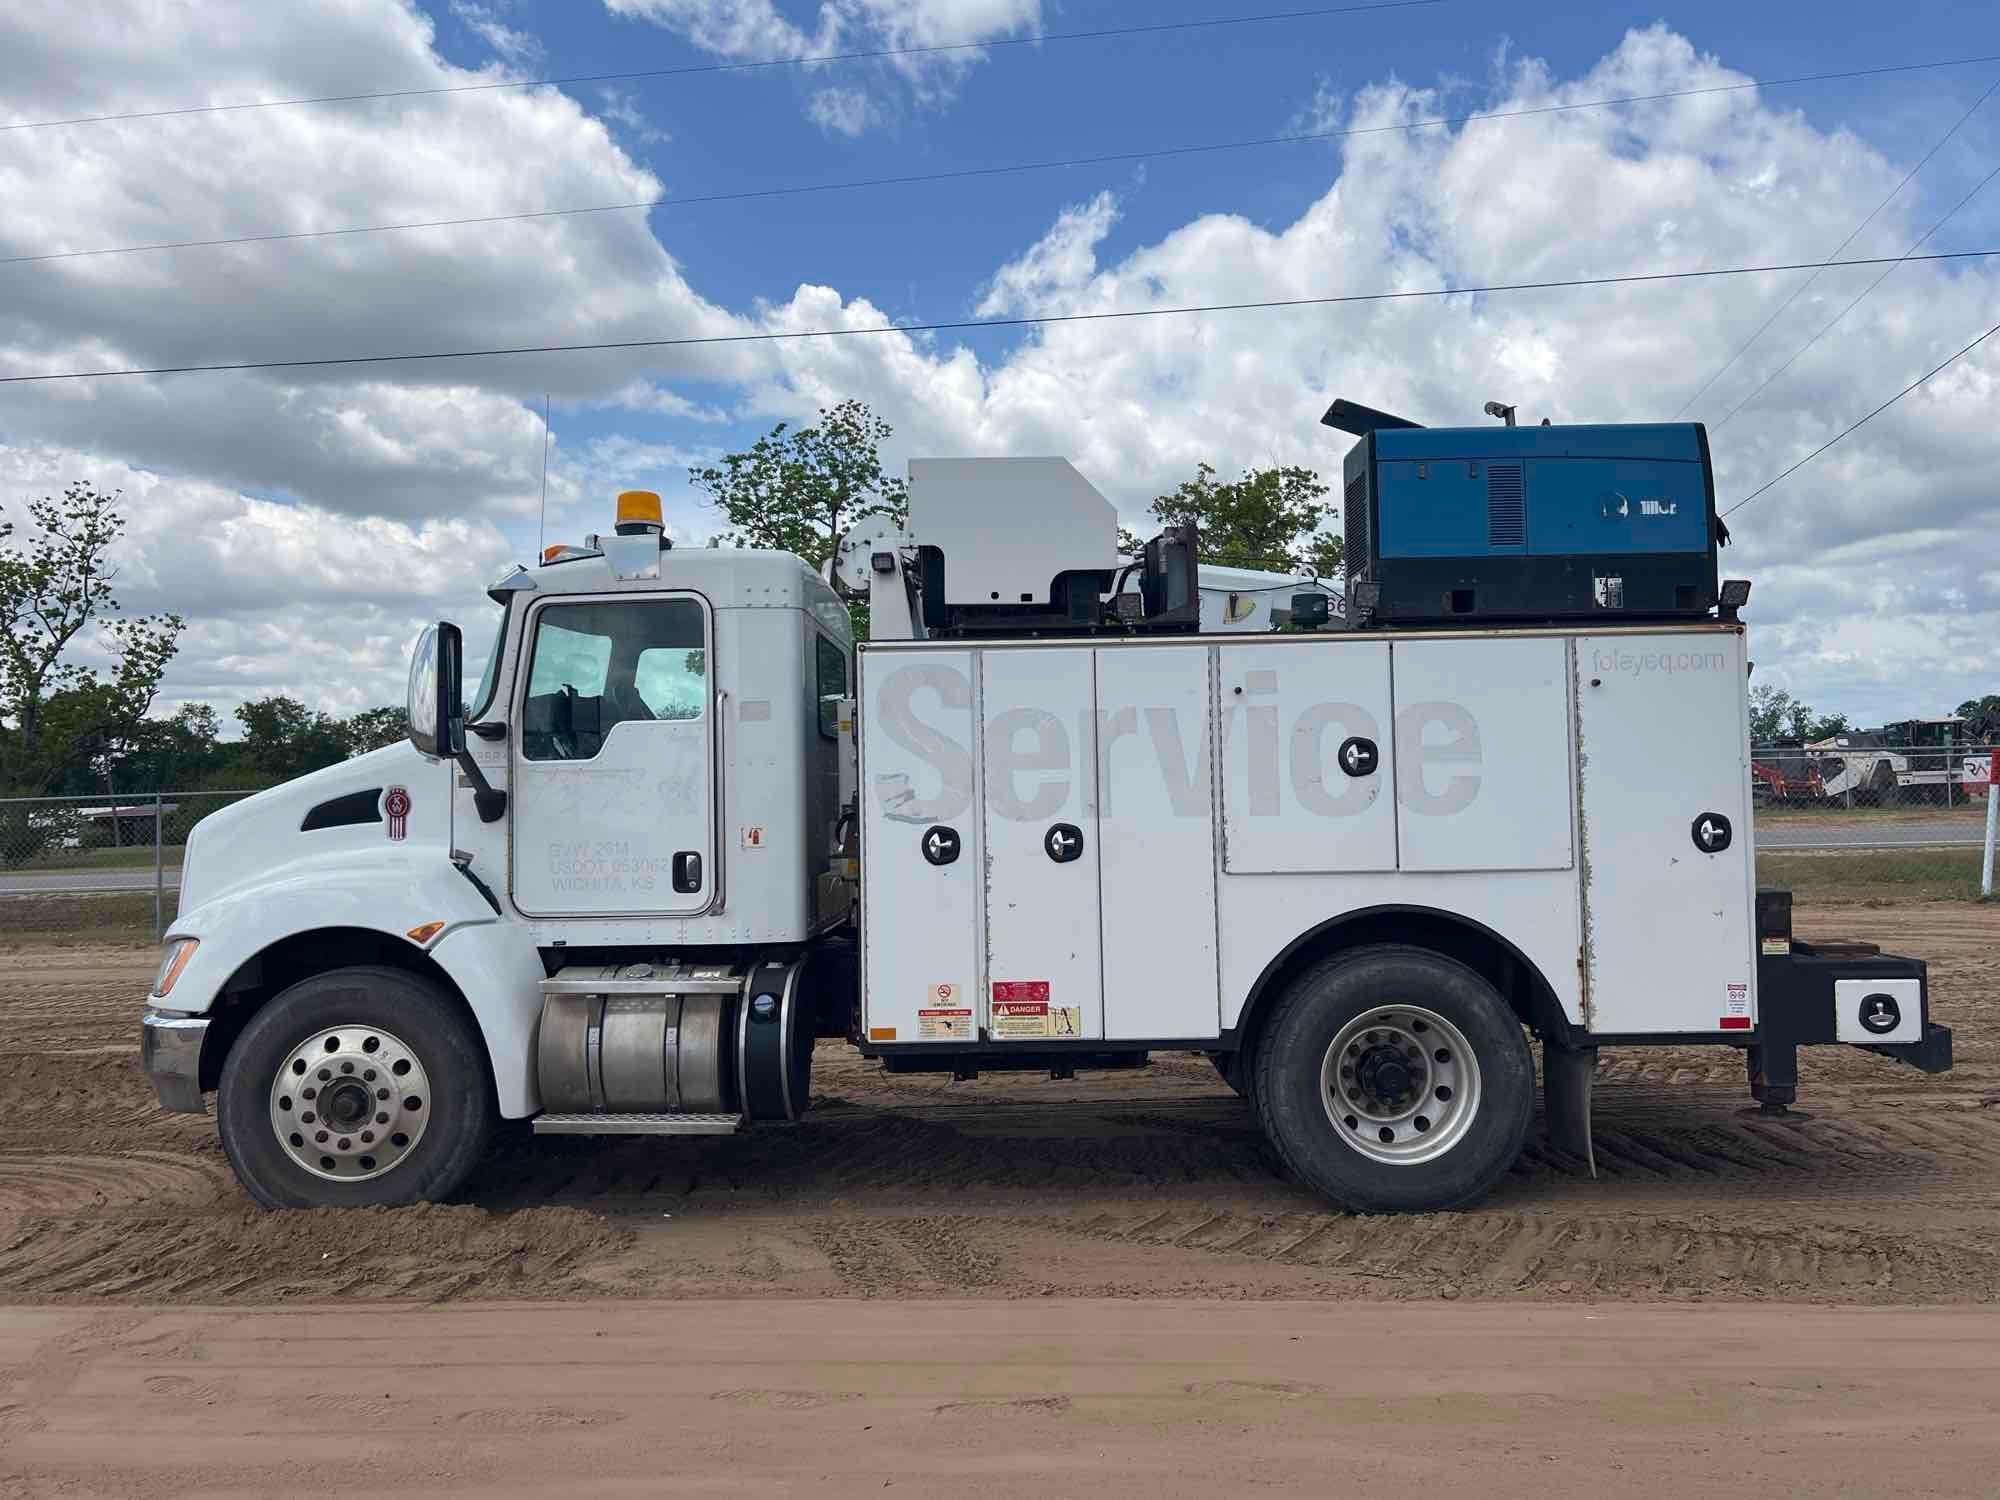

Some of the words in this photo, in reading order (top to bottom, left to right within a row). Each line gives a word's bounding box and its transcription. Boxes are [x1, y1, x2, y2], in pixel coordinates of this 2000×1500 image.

[1592, 649, 1725, 676] foleyeq.com
[876, 662, 1483, 824] Service
[632, 875, 657, 892] KS
[1010, 1006, 1041, 1014] DANGER
